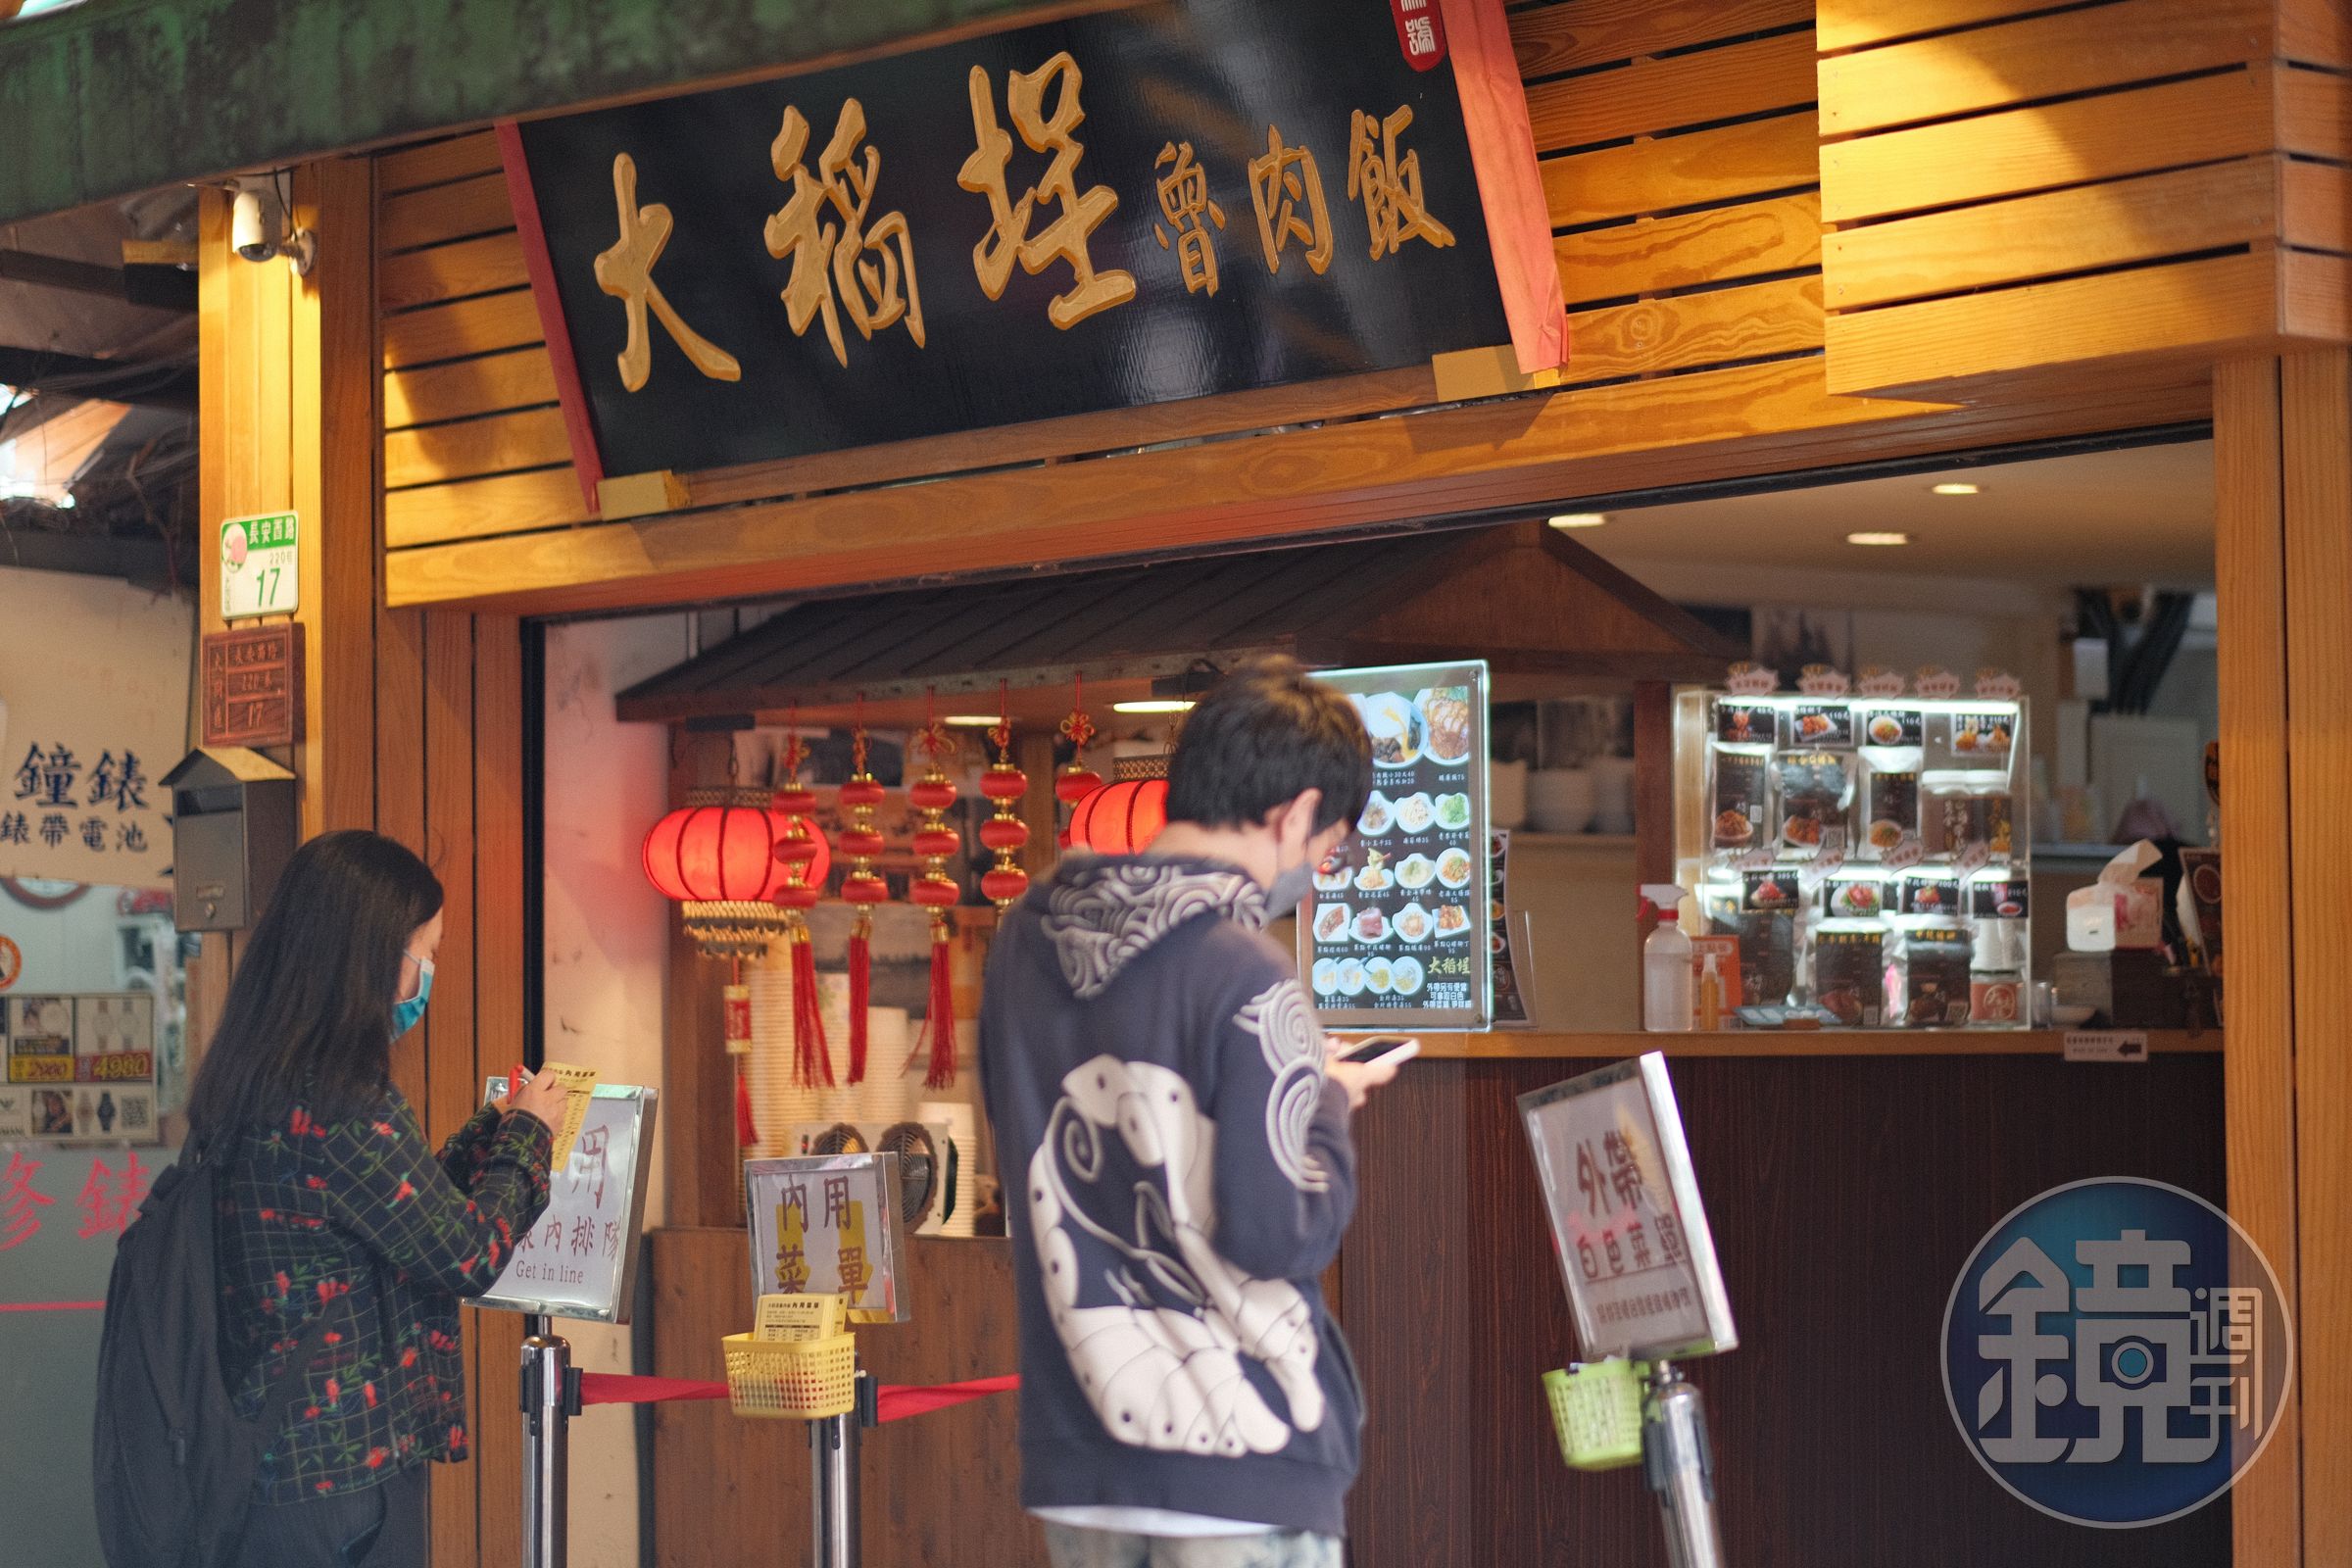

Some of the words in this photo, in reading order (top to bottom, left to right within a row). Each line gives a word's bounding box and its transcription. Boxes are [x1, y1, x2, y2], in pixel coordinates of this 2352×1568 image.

[250, 516, 294, 545] 長安西路
[257, 567, 280, 608] 17
[249, 702, 264, 728] 17
[15, 741, 148, 812] 鐘錶
[0, 810, 147, 853] 錶帶電池
[1427, 956, 1470, 975] 大稻埕
[1577, 1129, 1642, 1218] 外帶
[779, 1174, 852, 1232] 內用
[516, 1260, 535, 1279] Get
[542, 1263, 555, 1281] in
[560, 1265, 584, 1284] line
